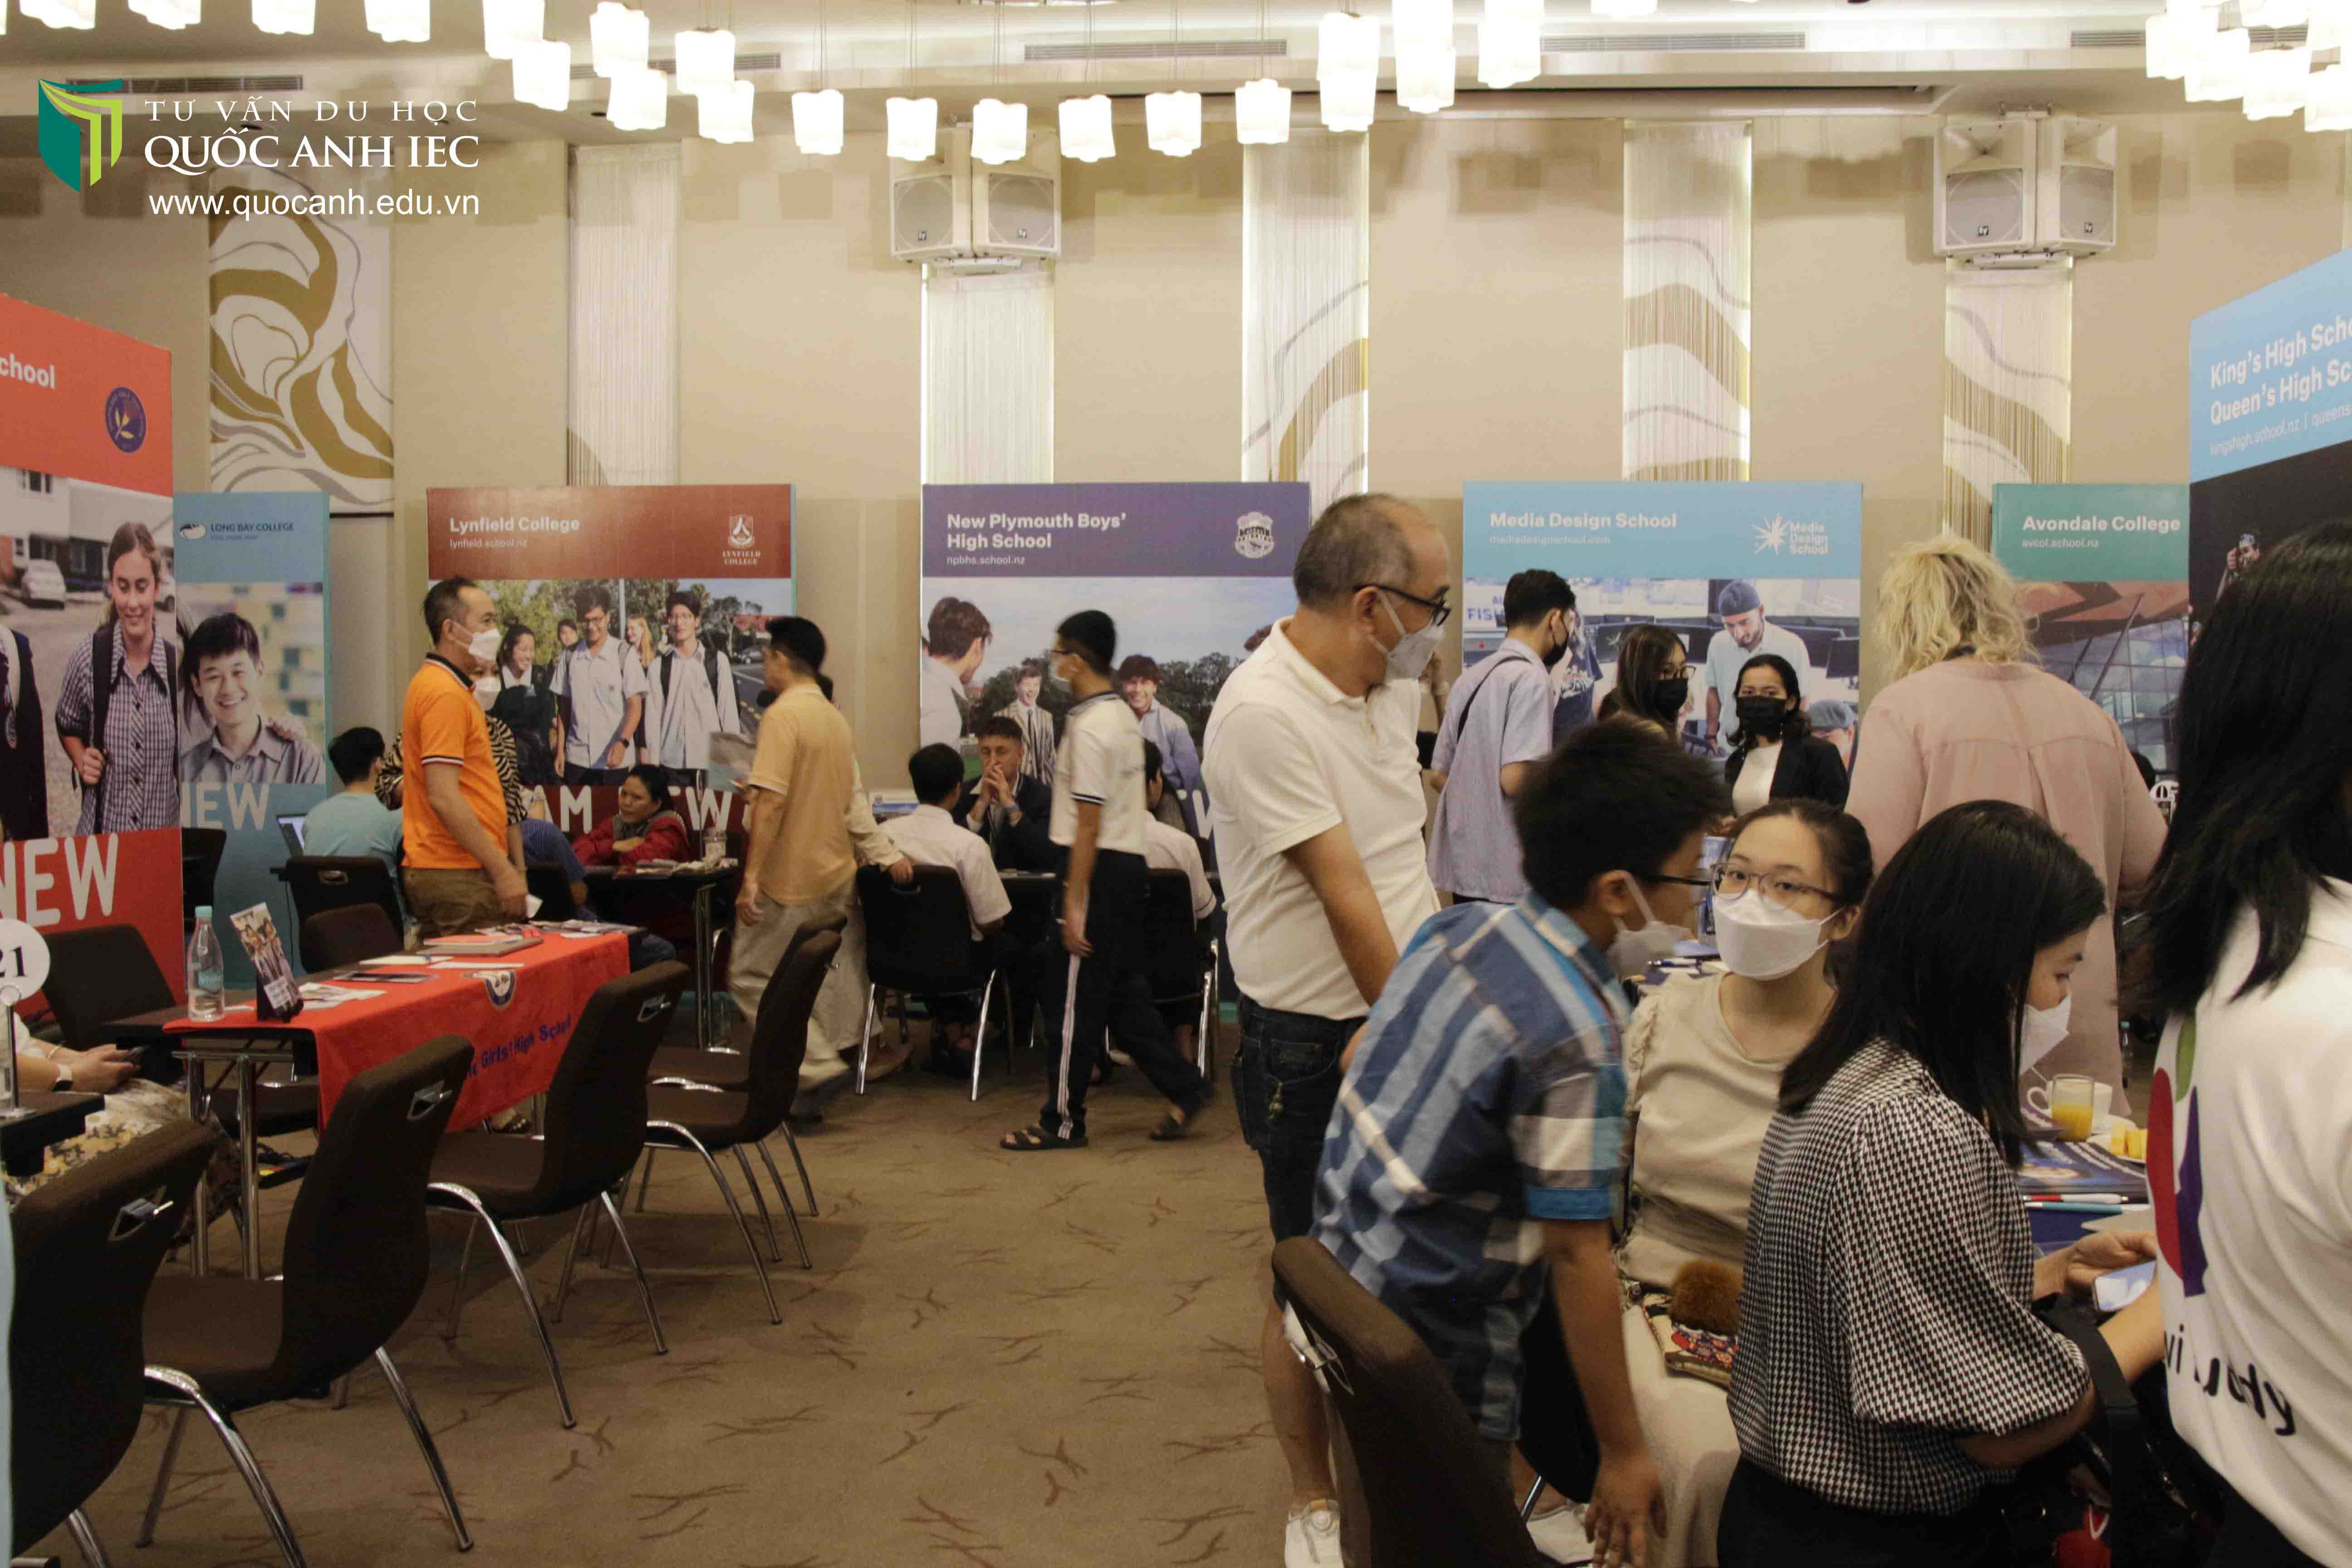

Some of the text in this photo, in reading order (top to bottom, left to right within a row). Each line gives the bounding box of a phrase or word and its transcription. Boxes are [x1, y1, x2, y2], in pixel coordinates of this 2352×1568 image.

[2265, 330, 2308, 369] High
[2279, 365, 2323, 403] High
[211, 522, 294, 533] LONG BAY COLLEGE
[450, 517, 581, 534] Lynfield College
[947, 514, 985, 529] New
[989, 513, 1073, 531] Plymouth
[1489, 512, 1677, 530] Media Design School
[1789, 523, 1825, 532] Media
[2023, 515, 2180, 534] Avondale College
[947, 533, 1052, 551] High School
[1789, 533, 1829, 544] Design
[1789, 544, 1829, 554] School
[946, 554, 1025, 566] npbhs.school.nz
